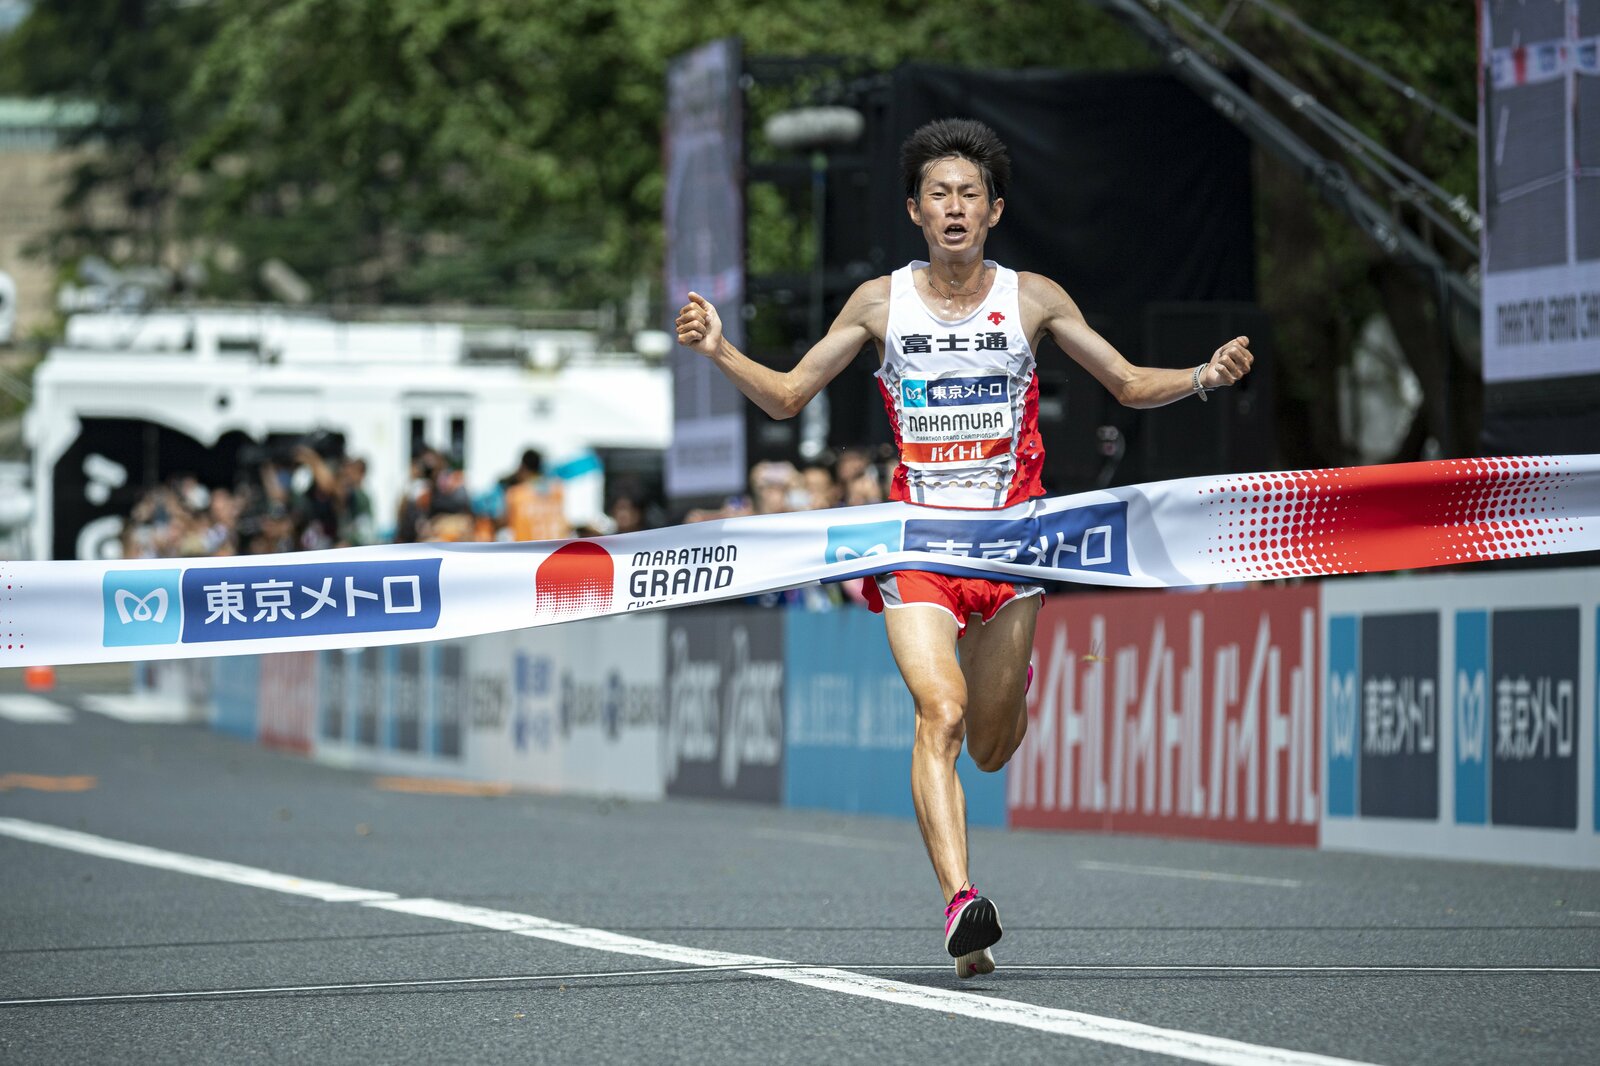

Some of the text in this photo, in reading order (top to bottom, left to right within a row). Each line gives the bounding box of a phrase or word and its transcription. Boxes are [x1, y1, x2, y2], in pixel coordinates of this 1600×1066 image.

[901, 332, 1008, 354] 富士通
[932, 383, 1002, 399] 東京メトロ
[909, 412, 1004, 432] NAKAMURA
[961, 432, 1000, 440] CHAMPIONSHIP
[931, 442, 984, 461] バイトル
[632, 545, 737, 567] MARATHON
[629, 565, 734, 597] GRAND
[203, 575, 422, 625] 東京メトロ
